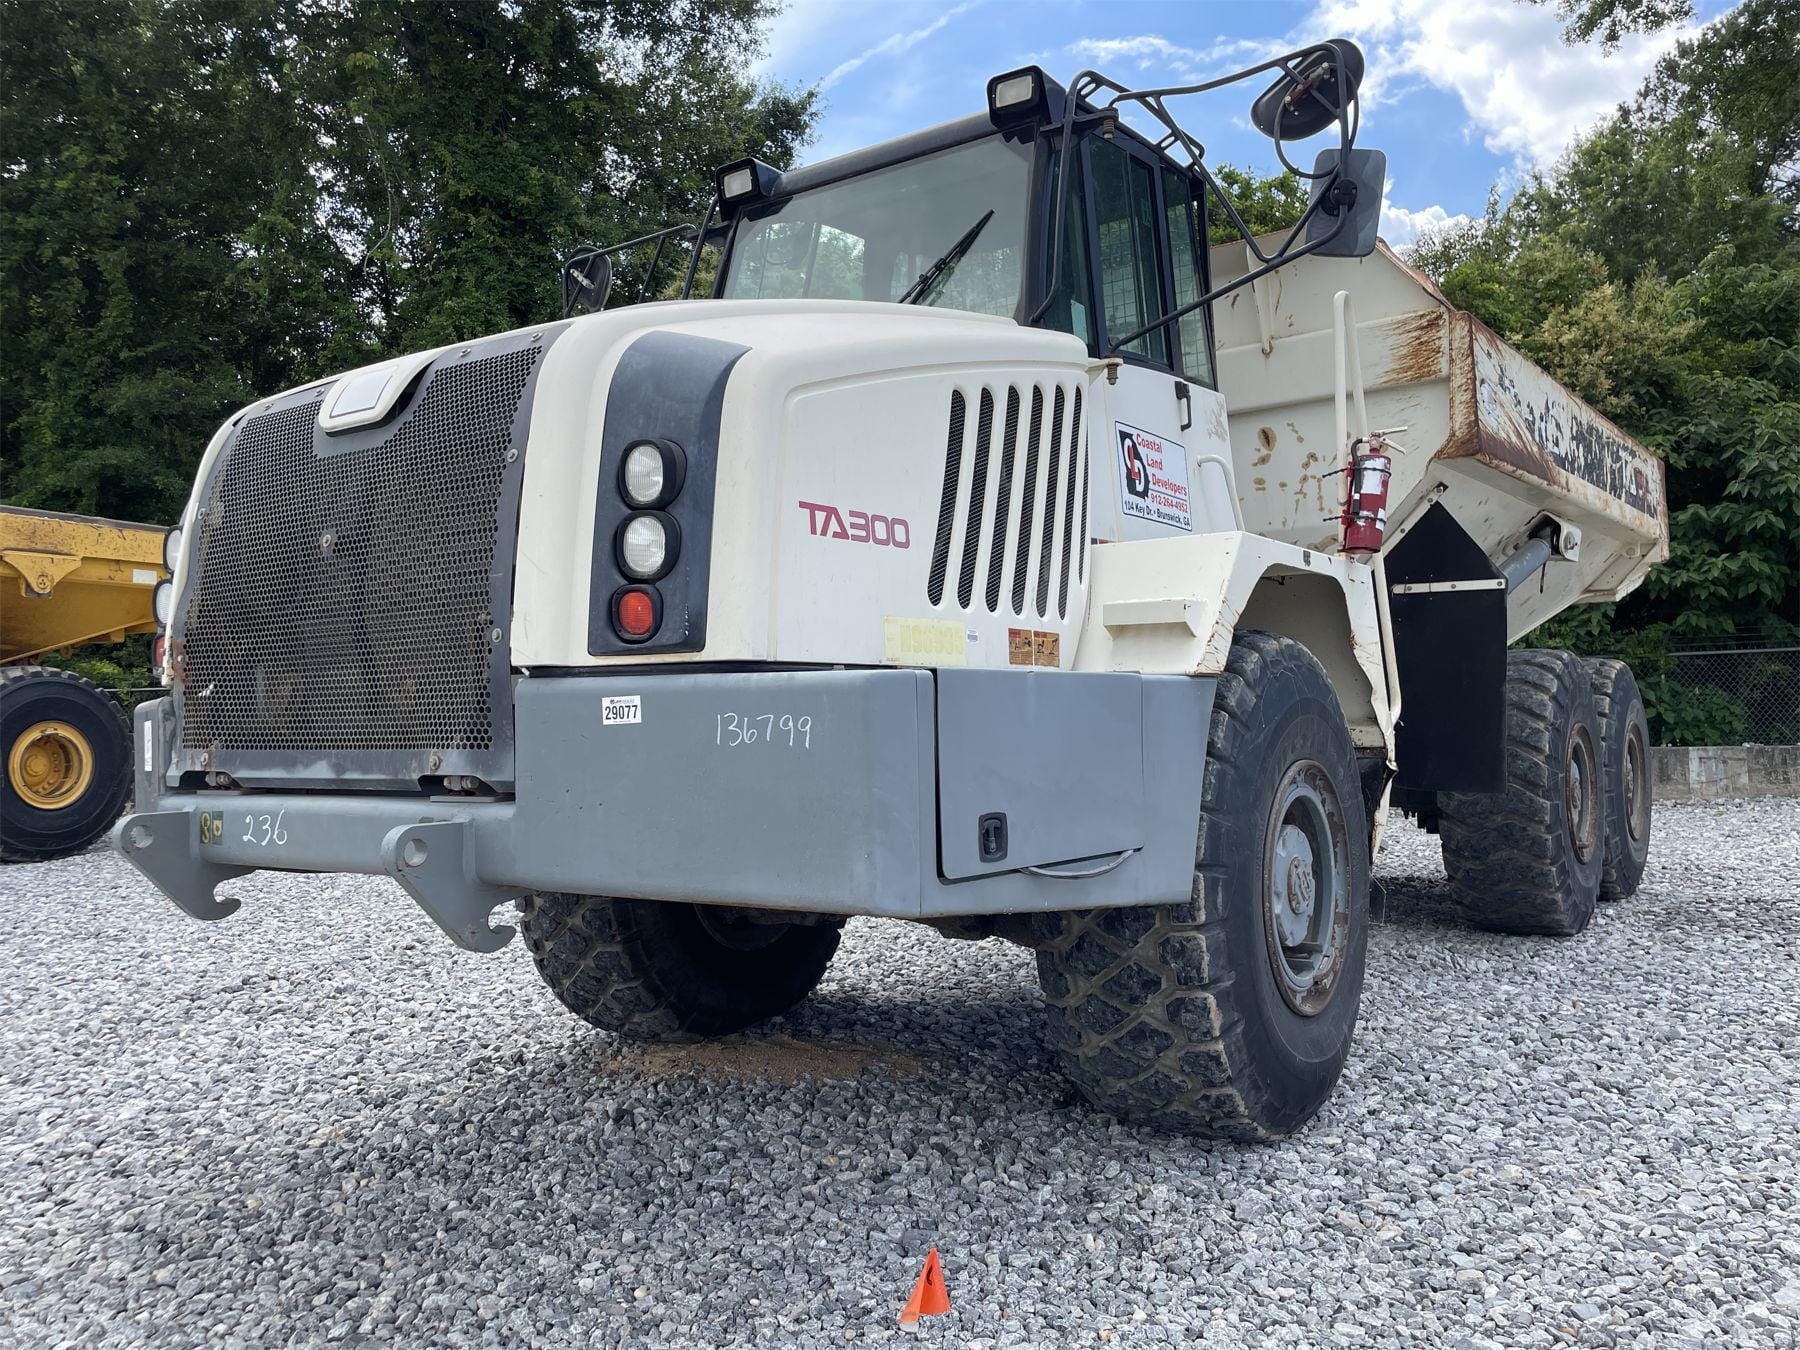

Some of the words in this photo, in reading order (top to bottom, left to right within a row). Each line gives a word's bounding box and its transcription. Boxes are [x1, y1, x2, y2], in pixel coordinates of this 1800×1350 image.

[1136, 433, 1162, 454] Coastal
[1146, 454, 1163, 471] Land
[1151, 472, 1187, 496] Developers
[1135, 503, 1145, 516] Key
[1157, 508, 1182, 525] Brunswick,
[1183, 516, 1191, 527] GA
[1150, 493, 1188, 513] 912-264-4952
[798, 500, 910, 549] TA300
[604, 704, 638, 720] 29077
[716, 712, 812, 750] 136799
[242, 808, 288, 847] 236
